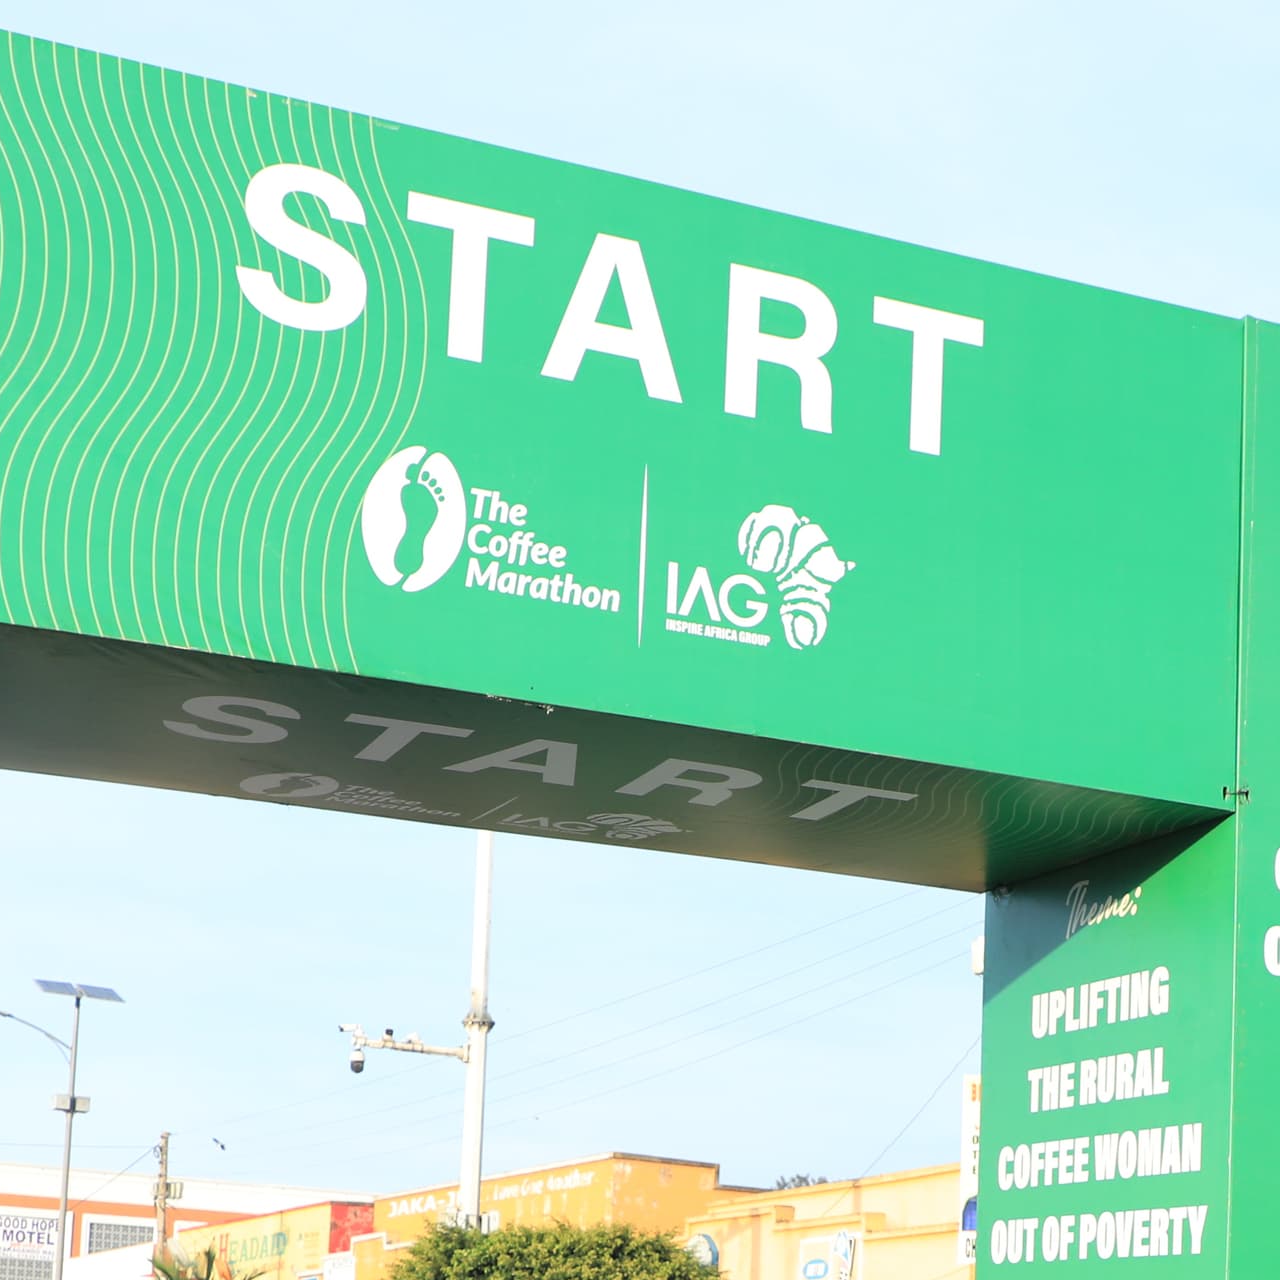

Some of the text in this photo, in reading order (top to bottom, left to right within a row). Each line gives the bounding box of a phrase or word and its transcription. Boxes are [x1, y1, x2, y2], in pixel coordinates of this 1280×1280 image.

[225, 161, 985, 456] START
[470, 487, 528, 527] The
[467, 523, 568, 569] Coffee
[464, 557, 622, 613] Marathon
[665, 561, 770, 628] IAG
[665, 618, 771, 647] INSPIRE AFRICA GROUP
[162, 695, 919, 822] START
[1065, 879, 1143, 941] Theme:
[1031, 966, 1170, 1039] UPLIFTING
[1027, 1046, 1170, 1113] THE RURAL
[997, 1122, 1203, 1191] COFFEE WOMAN
[2, 1230, 55, 1245] MOTEL
[990, 1204, 1209, 1265] OUT OF POVERTY
